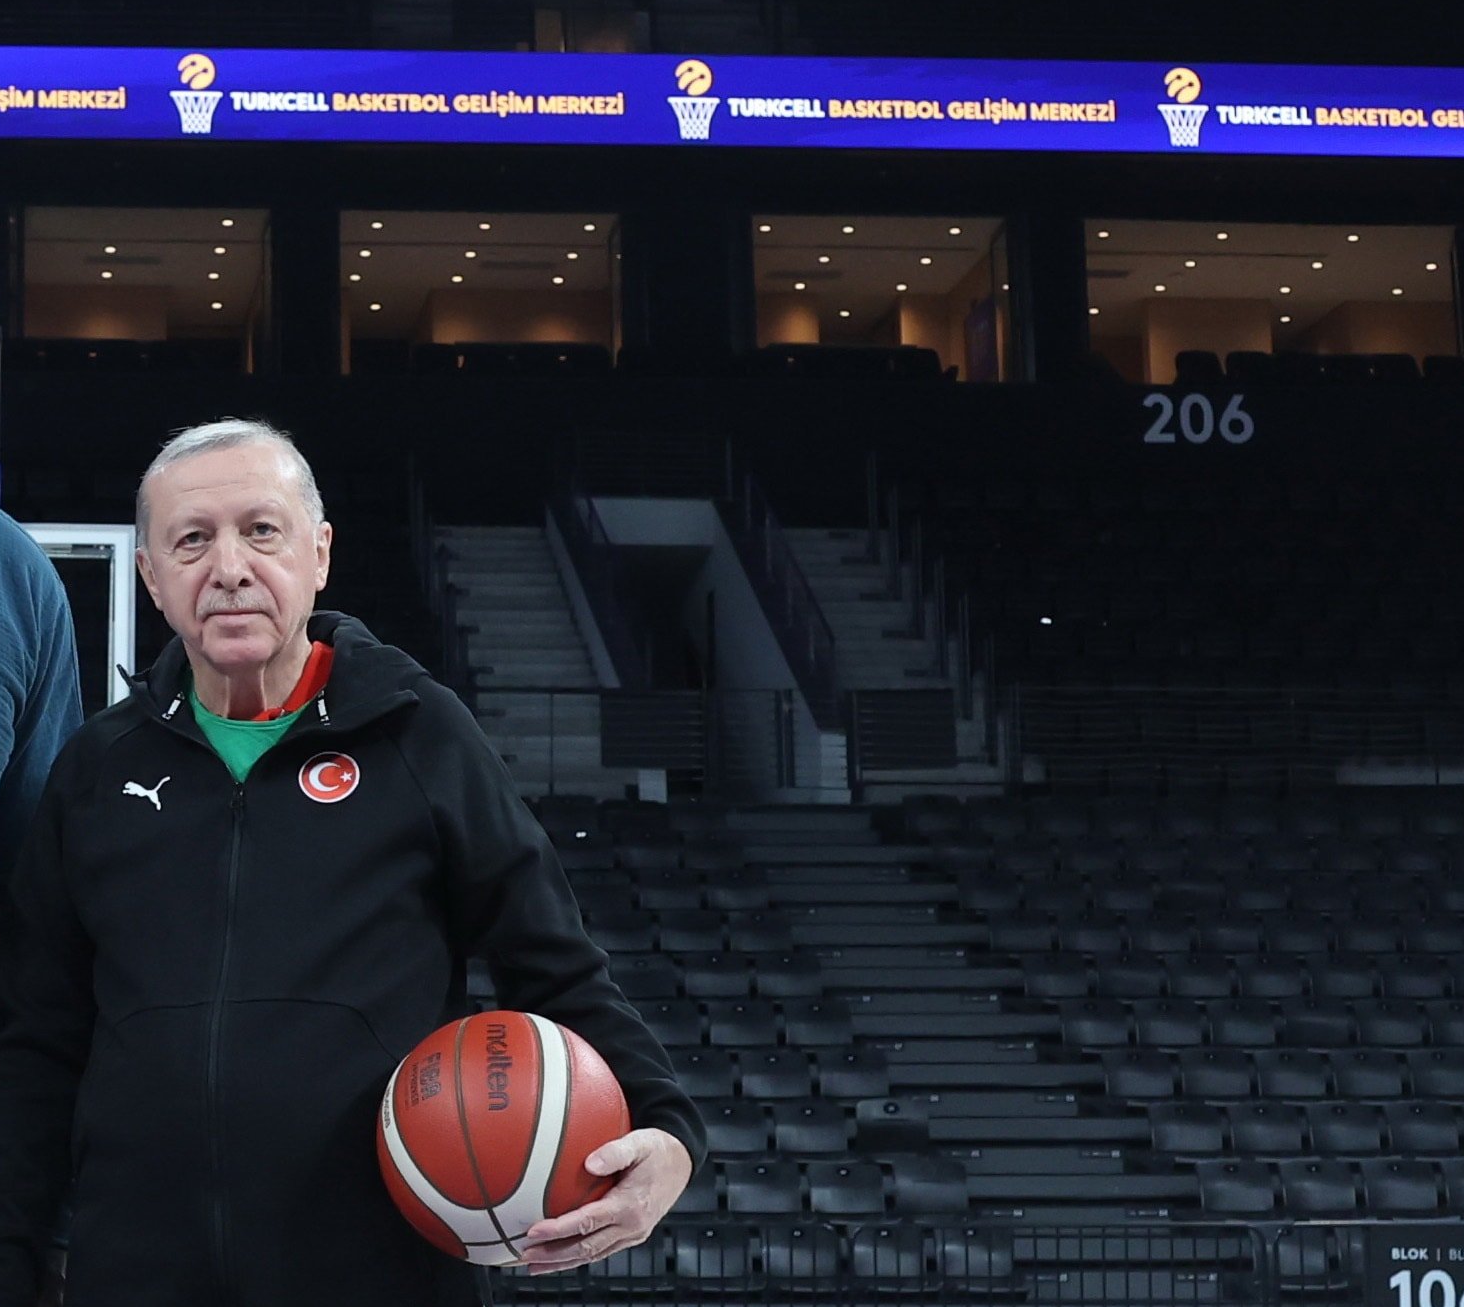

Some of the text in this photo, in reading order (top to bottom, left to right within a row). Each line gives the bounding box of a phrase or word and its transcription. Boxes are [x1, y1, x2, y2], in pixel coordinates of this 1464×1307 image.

[37, 86, 126, 110] MERKEZİ
[229, 90, 625, 118] TURKCELL BASKETBOL GELİŞİM MERKEZİ
[727, 97, 1116, 125] TURKCELL BASKETBOL GELİŞİM MERKEZİ
[1215, 105, 1313, 126] TURKCELL
[1315, 107, 1429, 128] BASKETBOL
[1142, 393, 1255, 444] 206
[485, 1023, 513, 1112] molten
[1391, 1247, 1429, 1261] BLOK
